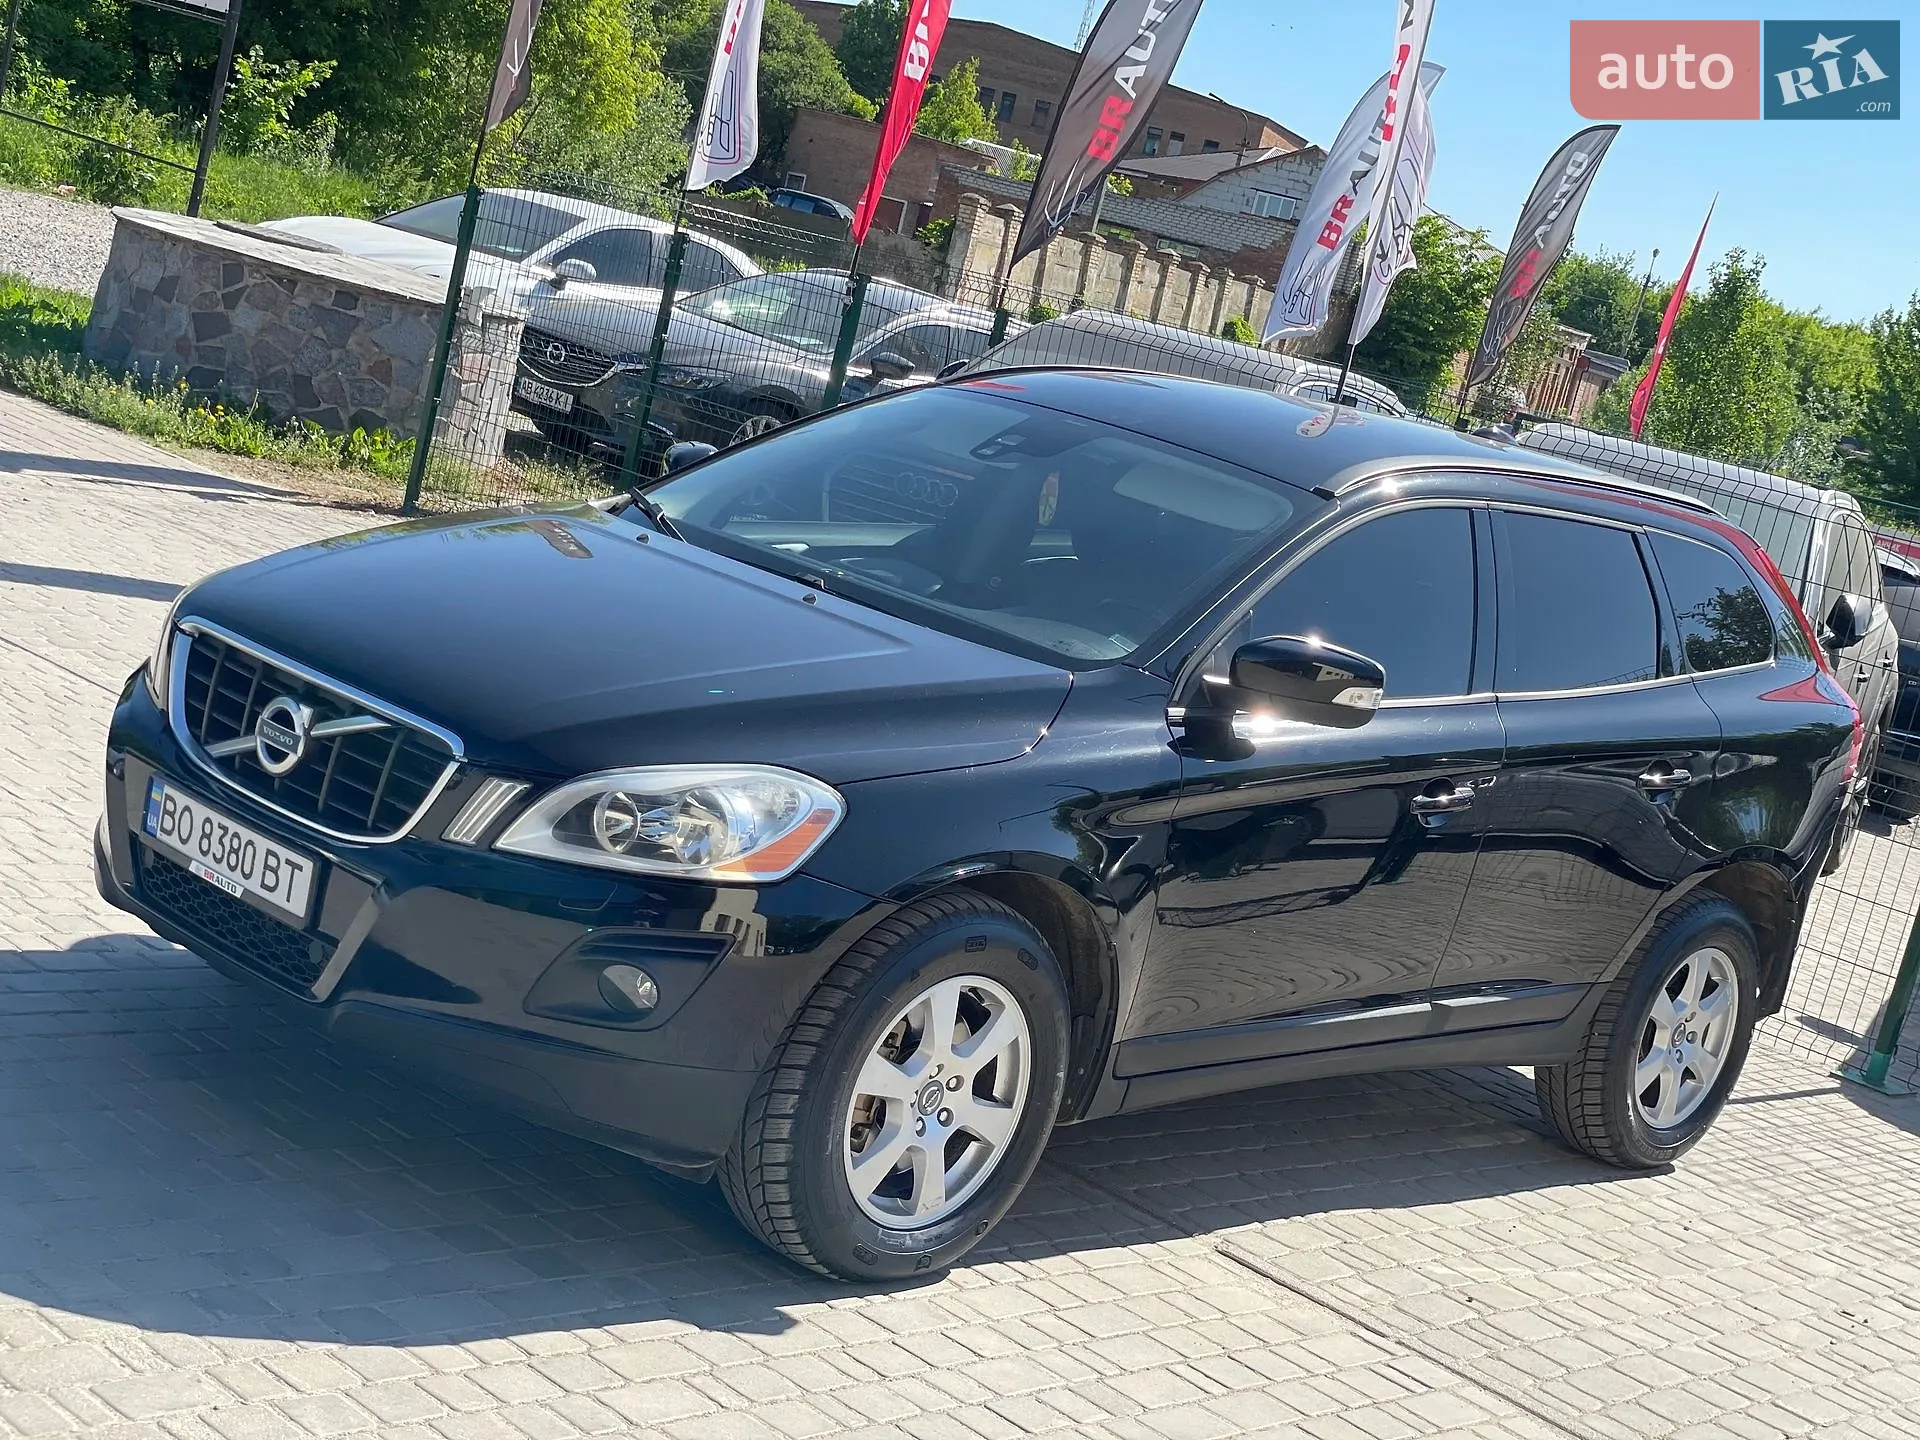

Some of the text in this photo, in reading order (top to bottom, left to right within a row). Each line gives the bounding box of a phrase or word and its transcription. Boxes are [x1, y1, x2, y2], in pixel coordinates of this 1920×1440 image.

[1087, 0, 1174, 162] BRAUT
[159, 792, 304, 903] BO 8380 BT
